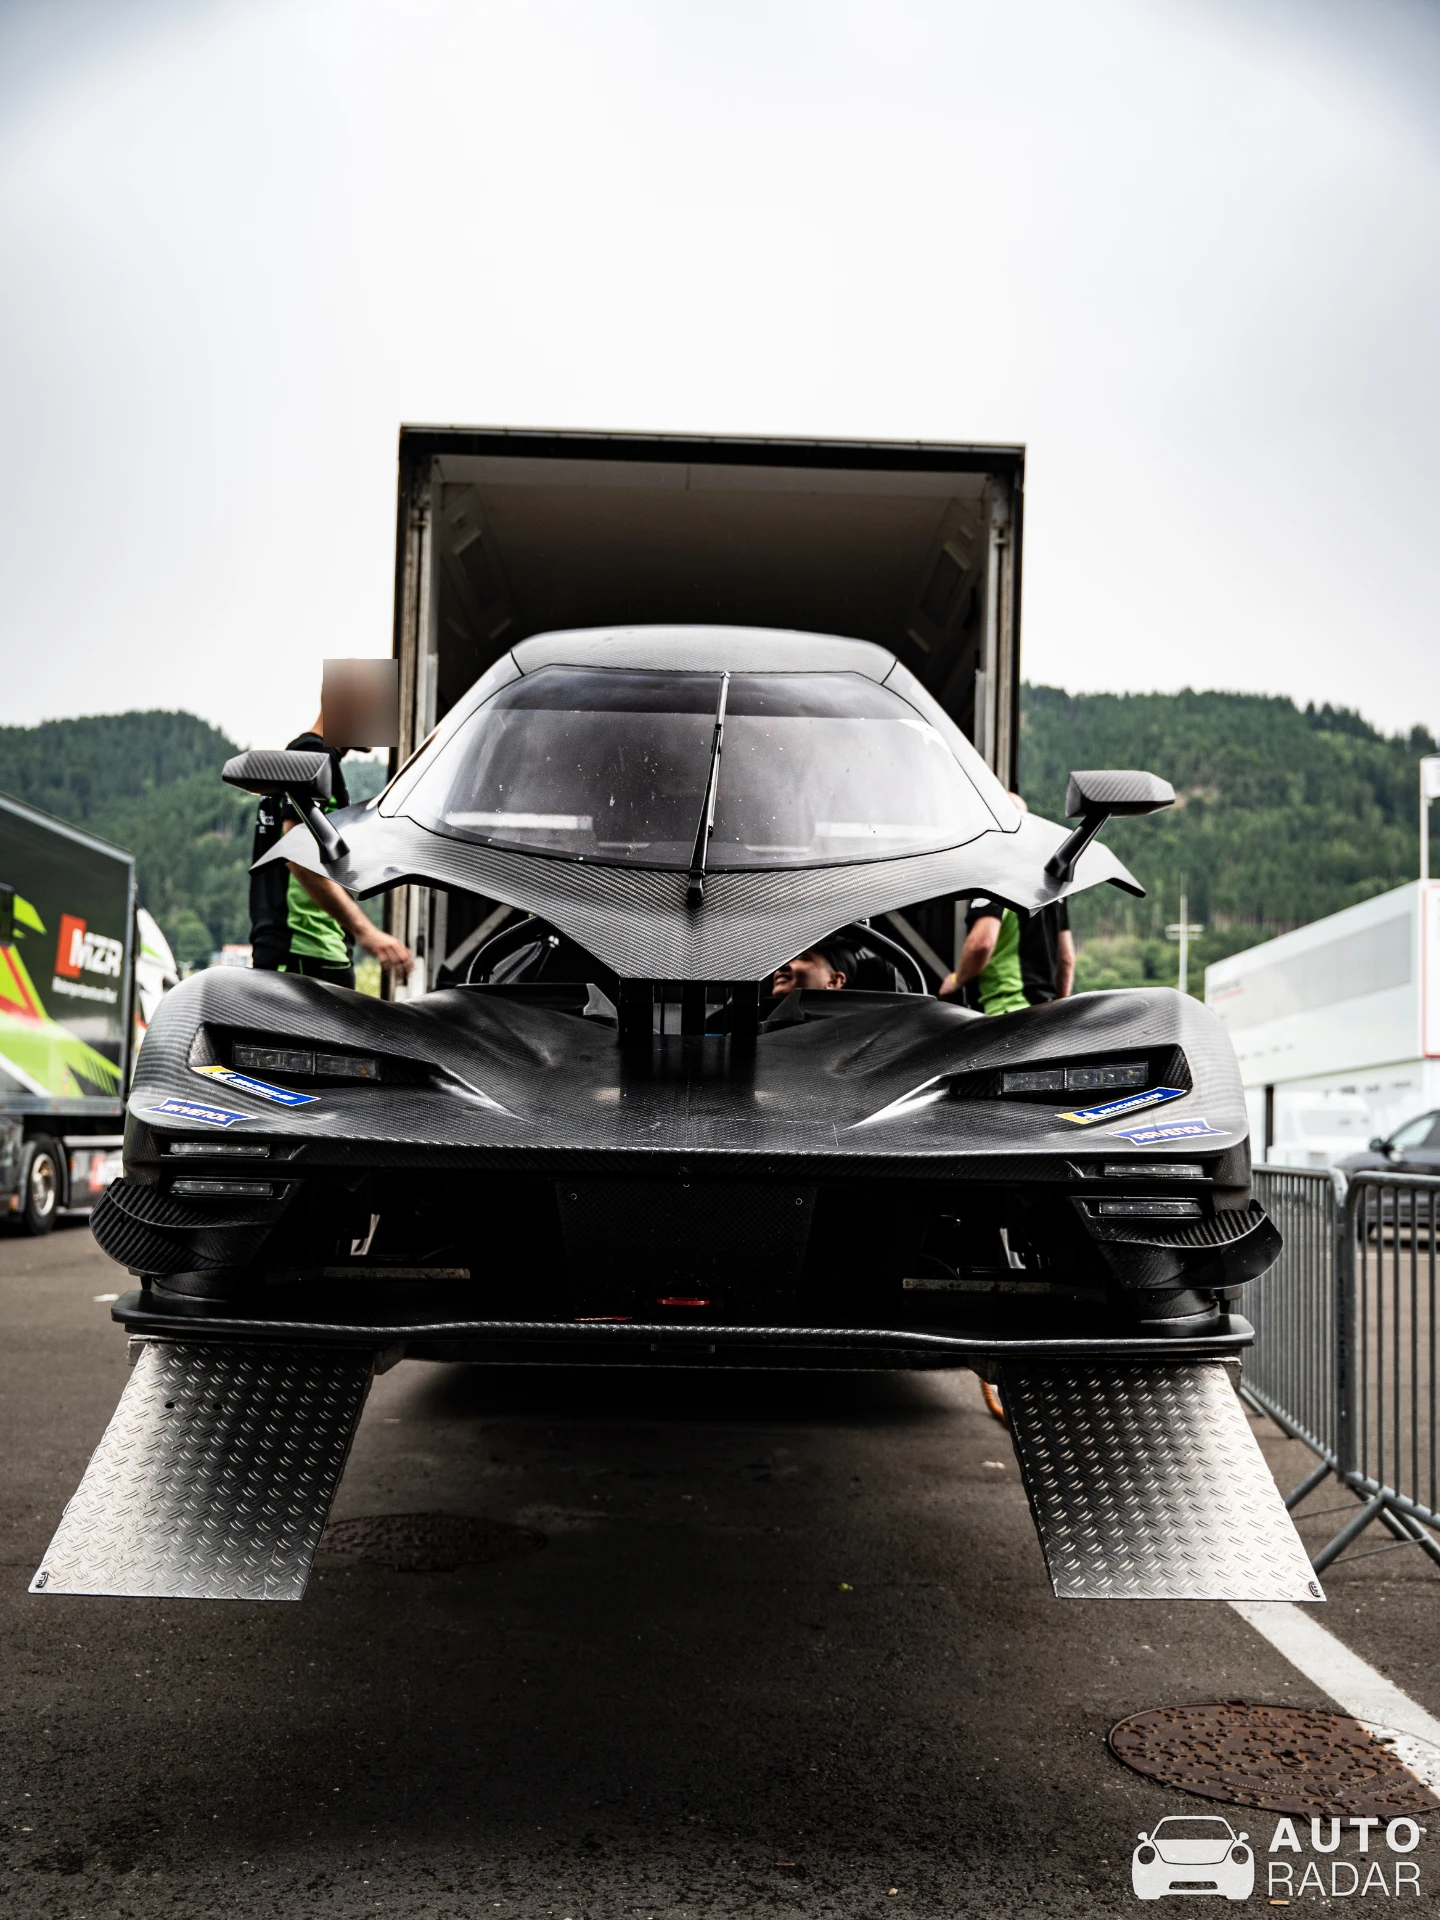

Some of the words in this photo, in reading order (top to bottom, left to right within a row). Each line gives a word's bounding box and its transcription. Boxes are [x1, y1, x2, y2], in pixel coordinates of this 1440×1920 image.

[69, 928, 124, 978] MZR
[1099, 1093, 1164, 1115] MICHELIN
[1131, 1125, 1211, 1142] RAVENOL
